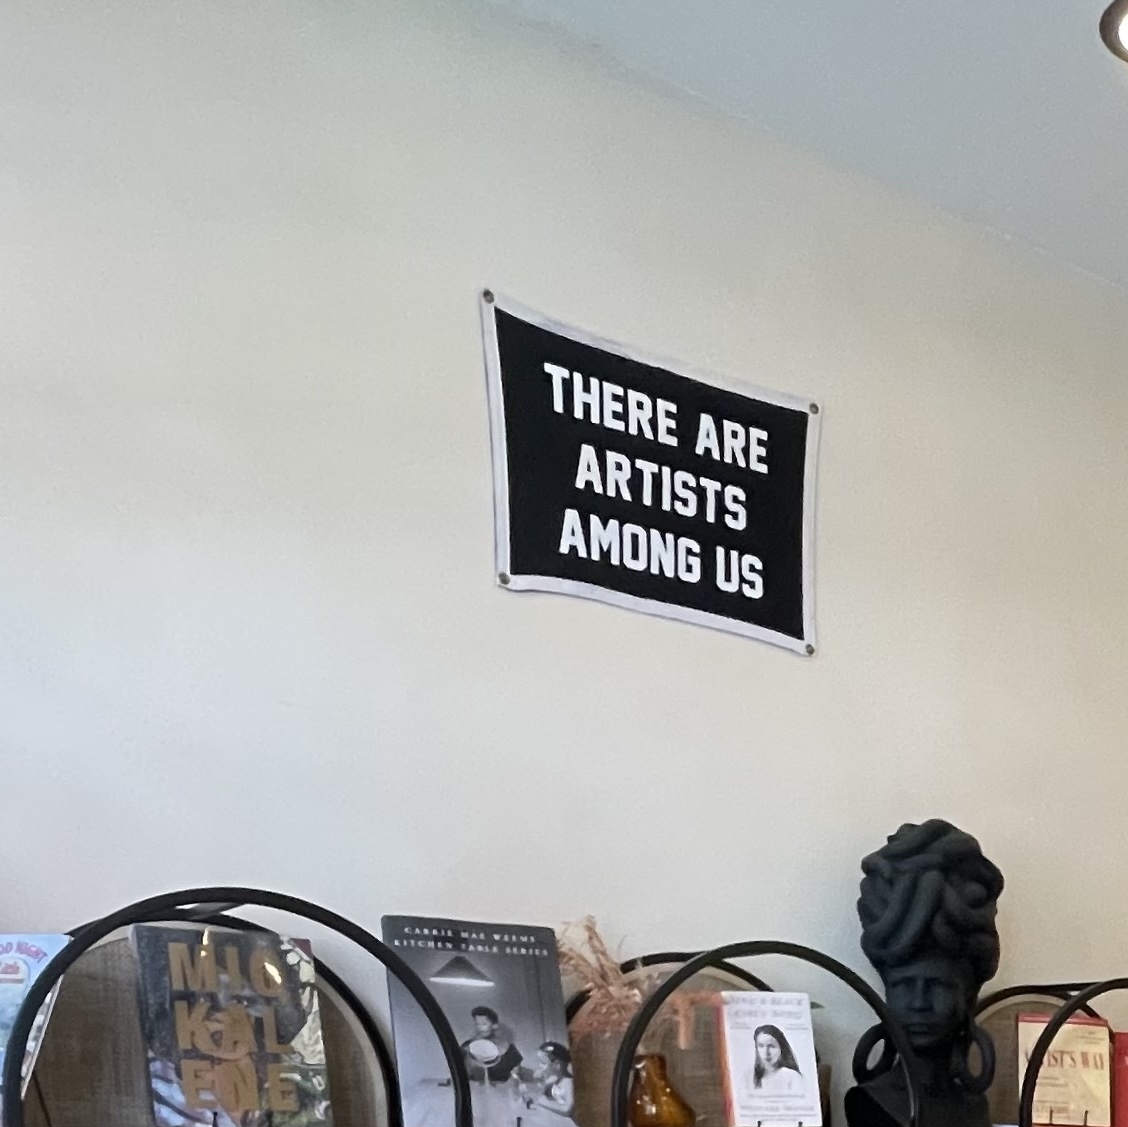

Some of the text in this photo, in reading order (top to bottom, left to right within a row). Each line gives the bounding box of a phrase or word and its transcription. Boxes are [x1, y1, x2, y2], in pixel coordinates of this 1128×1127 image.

[543, 362, 769, 474] THERE ARE
[574, 443, 747, 531] ARTISTS
[558, 508, 764, 600] AMONG US
[394, 939, 453, 949] KITCHEN
[404, 926, 454, 937] CARRIE
[493, 933, 536, 943] WEEMS
